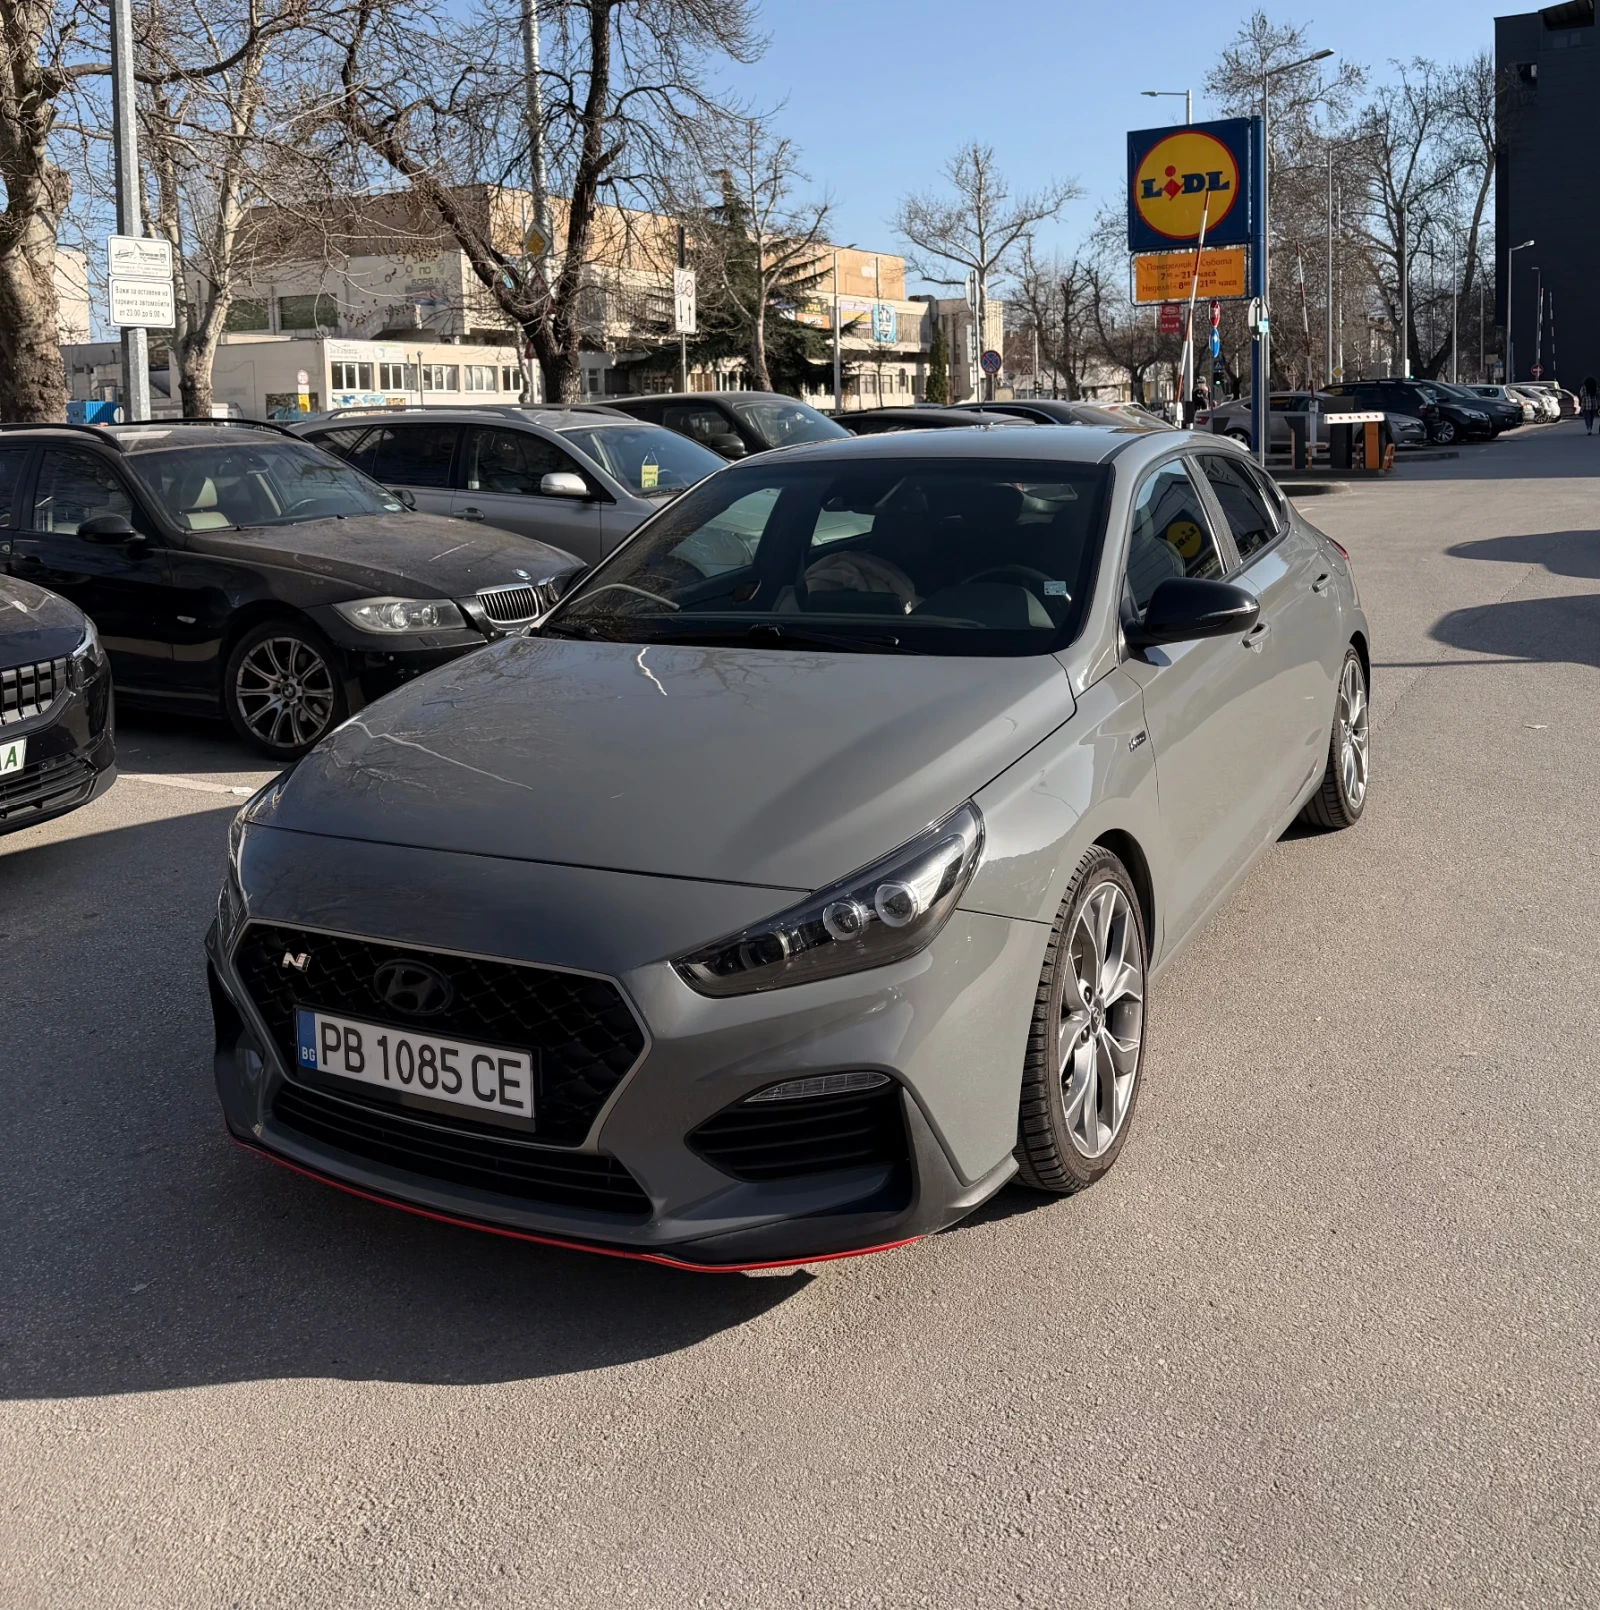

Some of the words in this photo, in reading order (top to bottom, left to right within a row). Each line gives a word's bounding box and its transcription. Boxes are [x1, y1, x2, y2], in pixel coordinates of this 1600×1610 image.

[1146, 260, 1192, 271] Понеделник
[1201, 258, 1232, 266] Събота
[411, 277, 440, 287] БОРБА
[115, 286, 129, 294] Важи
[301, 1046, 316, 1062] BG
[320, 1021, 366, 1074] PB
[377, 1035, 463, 1095] 1085
[471, 1053, 524, 1109] CE
